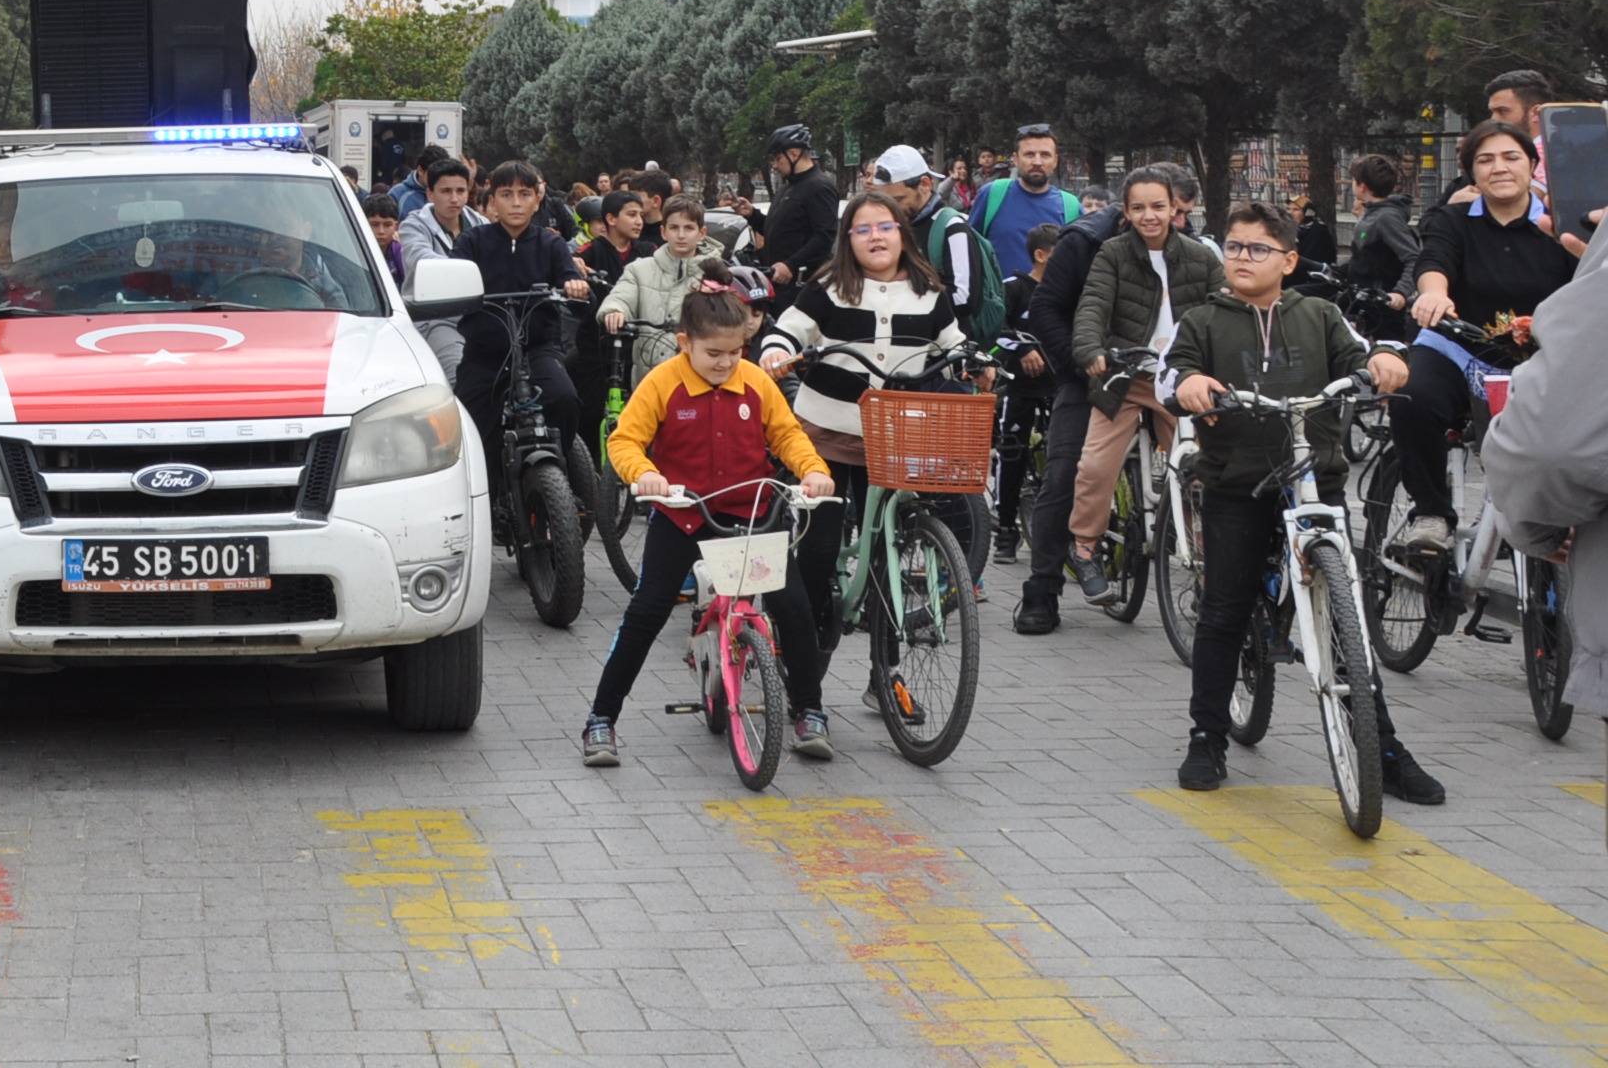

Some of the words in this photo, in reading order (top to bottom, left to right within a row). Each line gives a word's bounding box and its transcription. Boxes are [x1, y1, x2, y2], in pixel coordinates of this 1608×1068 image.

[38, 422, 304, 440] RANGER
[150, 469, 194, 490] Ford
[68, 564, 82, 574] TR
[82, 545, 120, 577] 45
[134, 545, 172, 577] SB
[180, 544, 256, 576] 5001
[67, 582, 101, 591] ISUZU
